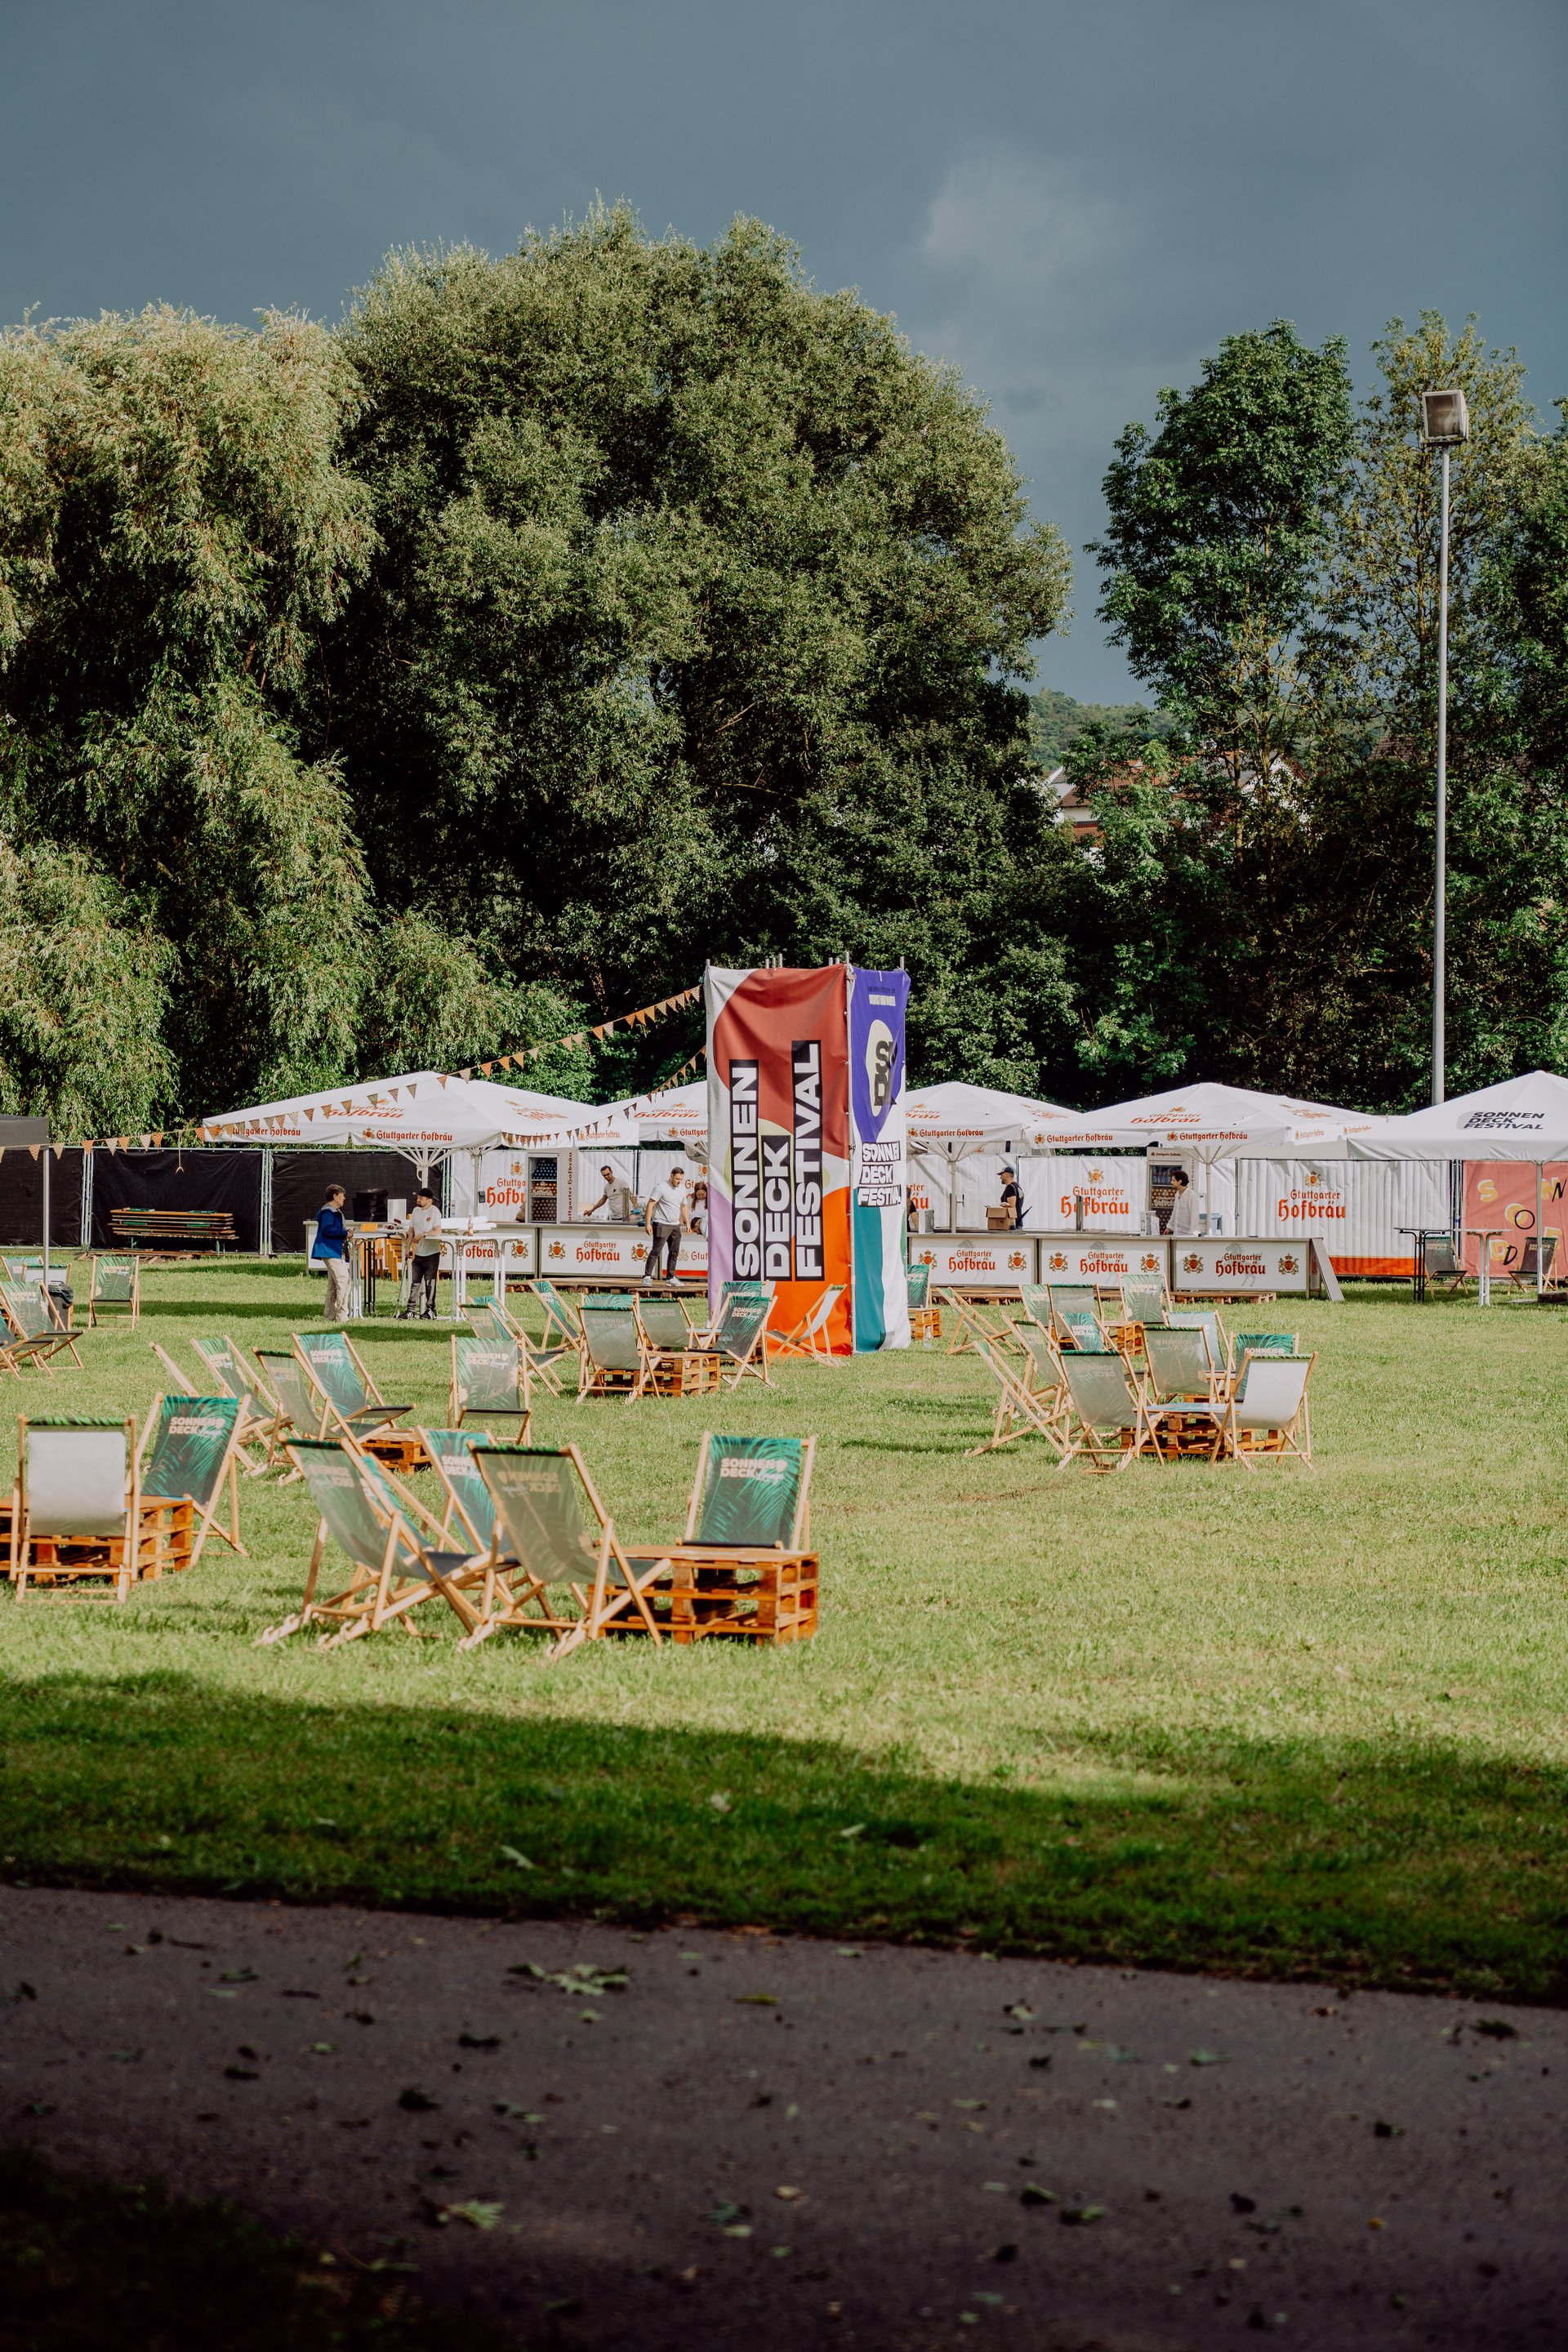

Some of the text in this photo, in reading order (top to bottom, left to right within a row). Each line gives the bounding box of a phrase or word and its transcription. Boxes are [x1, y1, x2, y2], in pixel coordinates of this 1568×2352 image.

[1130, 1116, 1202, 1124] Hofbräu
[1472, 1111, 1546, 1119] SONNEN
[270, 1127, 301, 1137] Hofbräu
[376, 1129, 452, 1141] Stuttgarter Hofbräu
[920, 1129, 984, 1138] Stuttgarter Hofbräu
[1179, 1131, 1248, 1143] Stuttgarter Hofbräu
[1046, 1134, 1113, 1144] Stuttgarter Hofbräu
[794, 1043, 822, 1278] FESTIVAL
[731, 1067, 760, 1278] SONNEN
[861, 1165, 893, 1184] DECK
[497, 1178, 526, 1189] Stuttga
[1072, 1186, 1125, 1199] Stuttgarter
[1290, 1189, 1340, 1201] Stuttgarter
[762, 1143, 791, 1278] DECK
[1061, 1195, 1129, 1218] Hfbräu
[1278, 1199, 1346, 1222] Hofbräu
[583, 1241, 617, 1250] Stuttgarter
[576, 1248, 620, 1263] Hofbräu
[956, 1250, 992, 1258] Stuttgarter
[1088, 1251, 1125, 1260] Stuttgarter
[1223, 1253, 1262, 1262] Stuttgarter
[948, 1256, 996, 1273] Hofbräu
[1080, 1258, 1129, 1275] Hofbräu
[1215, 1261, 1266, 1277] Hofbräu
[170, 1417, 216, 1426] SONNEN
[168, 1425, 199, 1435] DECK
[721, 1458, 776, 1469] SONNEN
[720, 1468, 756, 1478] DECK
